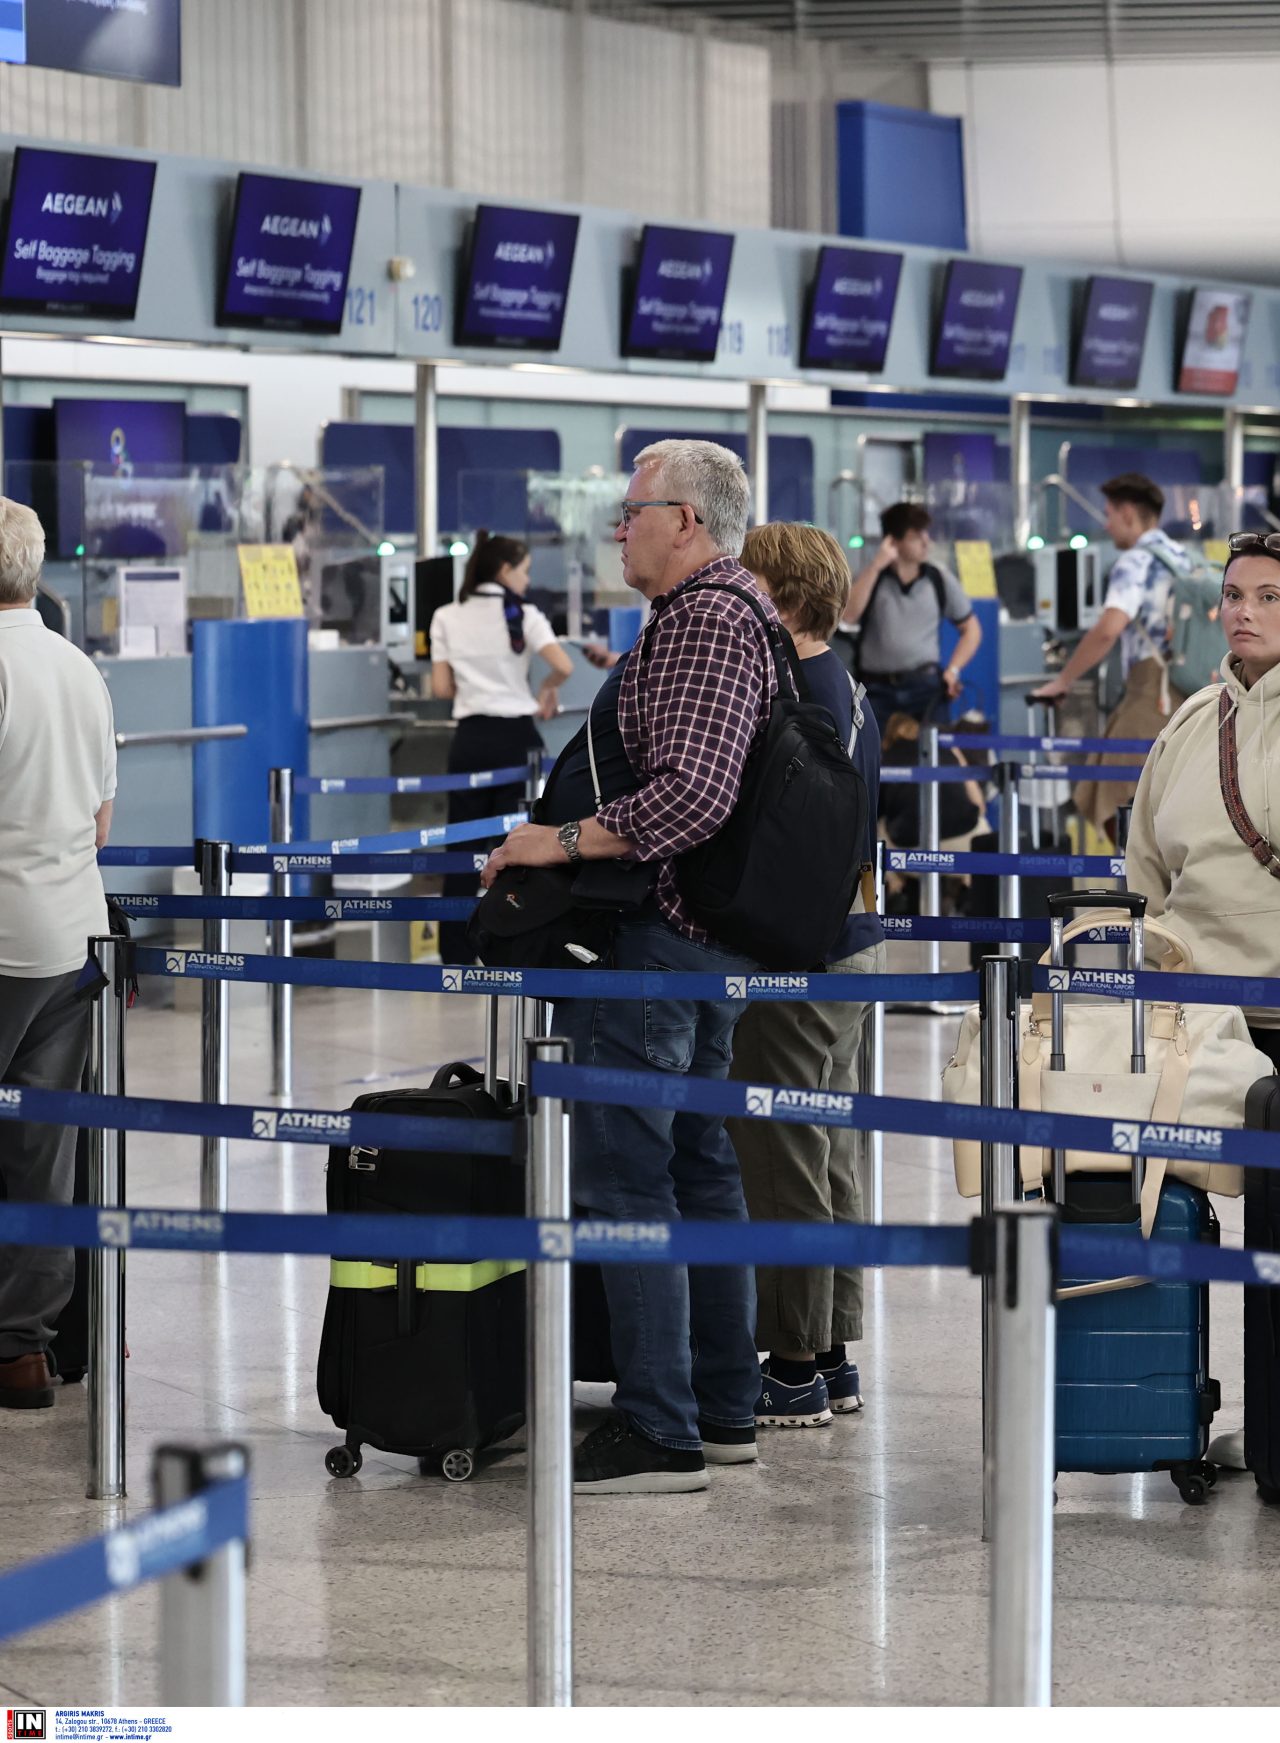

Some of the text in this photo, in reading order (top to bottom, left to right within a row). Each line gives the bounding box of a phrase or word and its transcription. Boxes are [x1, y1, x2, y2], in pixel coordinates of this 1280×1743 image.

[41, 191, 109, 217] AEGEAN
[260, 215, 319, 239] AEGEAN
[14, 238, 136, 273] Self Baggage Tagging
[411, 294, 442, 332] 120
[247, 845, 267, 853] ATHENS
[340, 839, 359, 849] ATHENS
[290, 856, 333, 866] ATHENS
[907, 852, 955, 864] ATHENS
[112, 896, 160, 906] ATHENS
[343, 899, 393, 910] ATHENS
[880, 918, 912, 928] HENS
[187, 952, 246, 967] ATHENS
[463, 970, 524, 983] ATHENS
[748, 976, 809, 989] ATHENS
[1071, 970, 1136, 985] ATHENS
[774, 1090, 854, 1111] ATHENS
[277, 1110, 352, 1130] ATHENS
[1141, 1124, 1224, 1145] ATHENS
[131, 1211, 225, 1232] ATHENS
[573, 1220, 671, 1243] ATHENS
